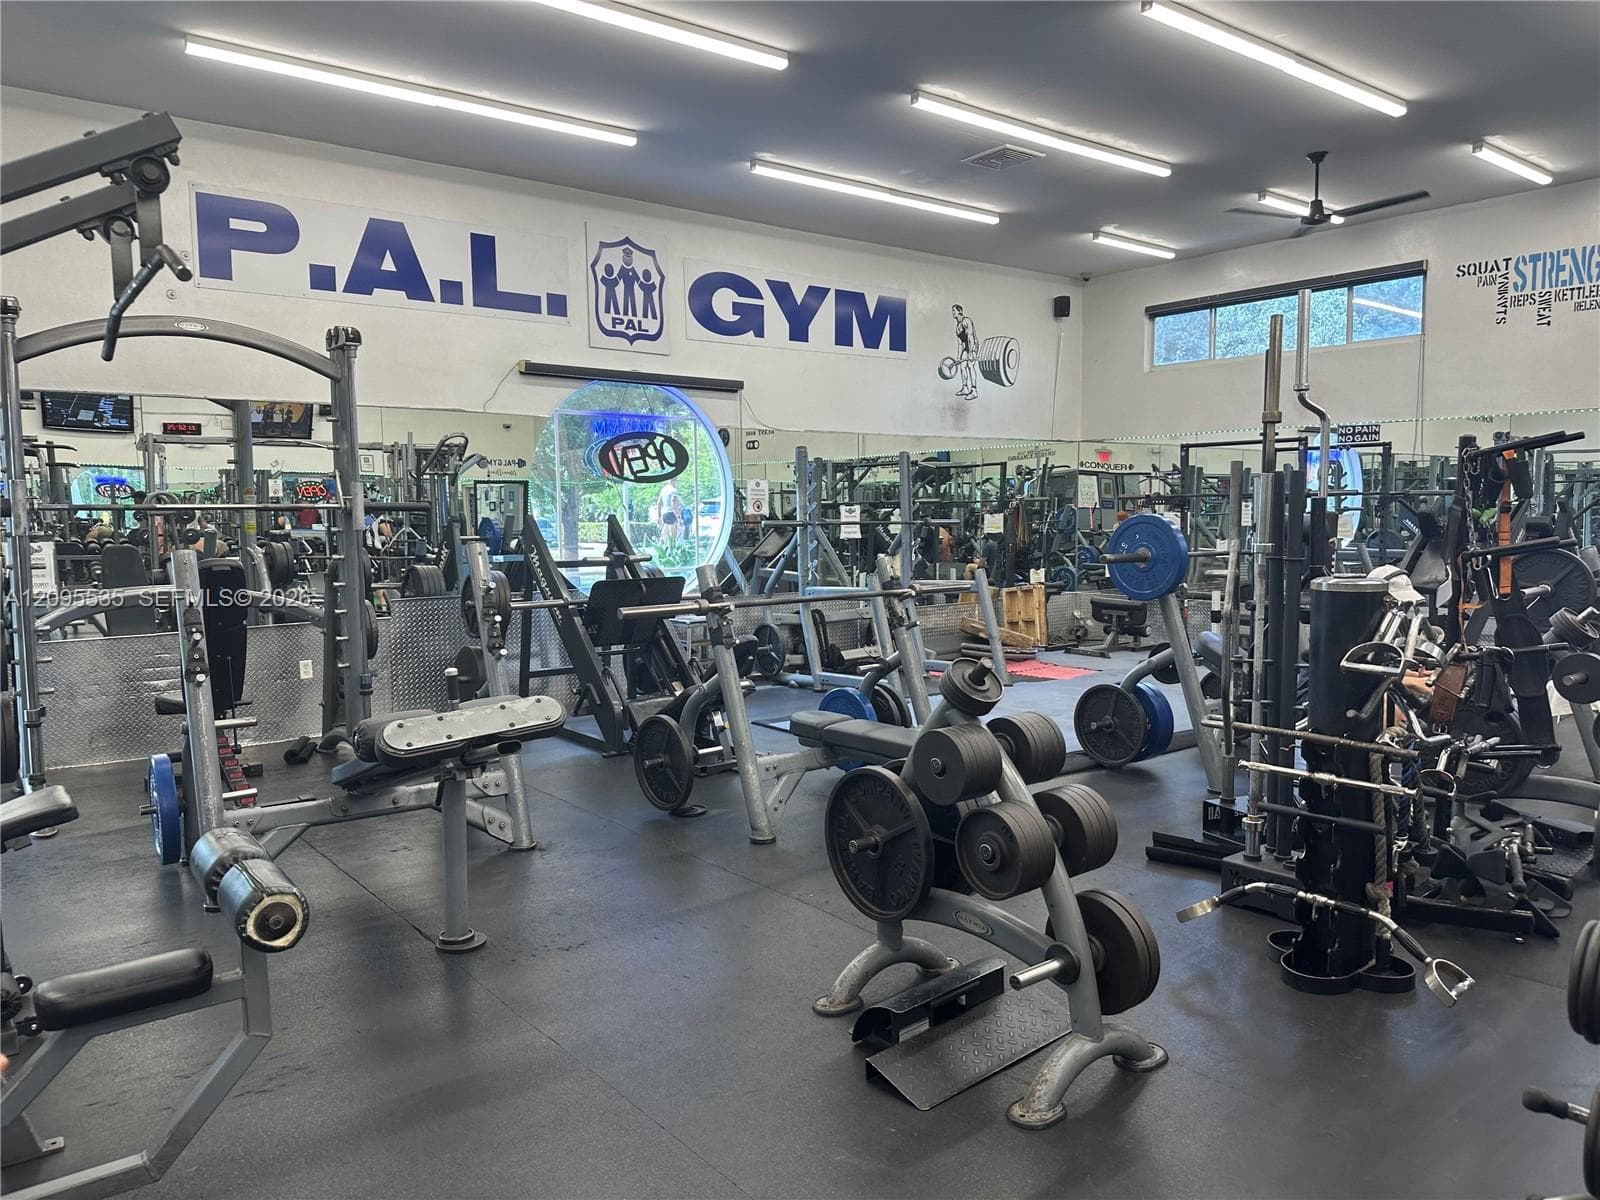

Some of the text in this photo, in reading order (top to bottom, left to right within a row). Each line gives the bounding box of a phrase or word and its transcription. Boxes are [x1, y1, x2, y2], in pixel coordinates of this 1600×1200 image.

[195, 191, 907, 352] P.A.L. GYM
[1456, 257, 1512, 278] SQUAT
[1477, 274, 1498, 287] PAIN
[1510, 293, 1536, 308] REPS
[1536, 290, 1552, 327] SWEAT
[611, 316, 649, 333] PAL
[1338, 425, 1379, 434] NO PAIN
[1354, 434, 1379, 442] GAIN
[1085, 461, 1127, 471] CONQUER
